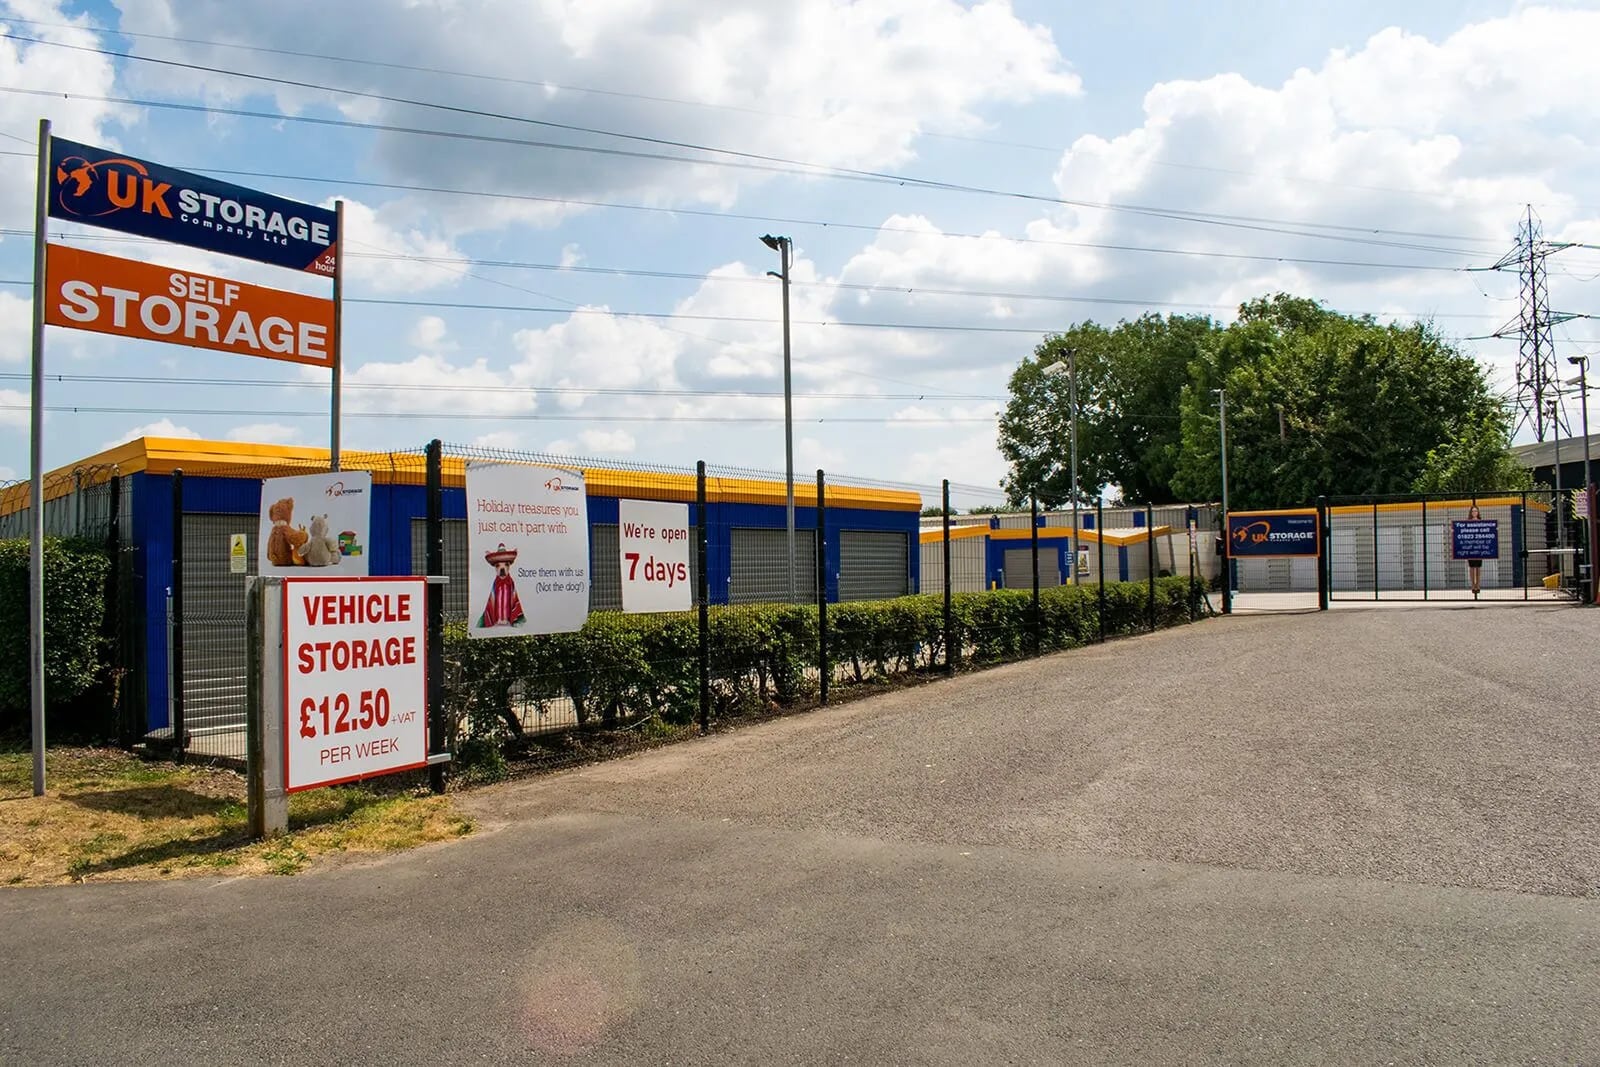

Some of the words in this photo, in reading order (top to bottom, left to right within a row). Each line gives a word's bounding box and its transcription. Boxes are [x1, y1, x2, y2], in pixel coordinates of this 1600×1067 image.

[107, 169, 173, 218] UK
[178, 189, 330, 246] STORAGE
[180, 213, 253, 238] Company
[263, 233, 288, 245] Ltd
[315, 260, 336, 273] hour
[325, 255, 336, 265] 24
[168, 273, 240, 306] SELF
[59, 280, 328, 360] STORAGE
[477, 499, 515, 516] Holiday
[518, 503, 561, 515] treasures
[562, 507, 579, 517] you
[478, 520, 497, 535] just
[499, 521, 524, 533] can't
[526, 523, 546, 536] part
[547, 522, 567, 534] with
[623, 522, 655, 539] We're
[661, 527, 687, 543] open
[1252, 533, 1268, 543] UK
[518, 567, 537, 578] Store
[538, 567, 557, 577] them
[558, 567, 574, 577] with
[575, 569, 584, 577] us
[624, 553, 640, 581] 7
[644, 556, 687, 588] days
[535, 582, 552, 593] (Not
[552, 582, 565, 591] the
[566, 582, 585, 593] dog!)
[303, 594, 411, 625] VEHICLE
[298, 636, 416, 675] STORAGE
[299, 688, 390, 739] £12.50
[391, 711, 416, 725] +VAT
[320, 745, 351, 766] PER
[355, 737, 399, 759] WEEK
